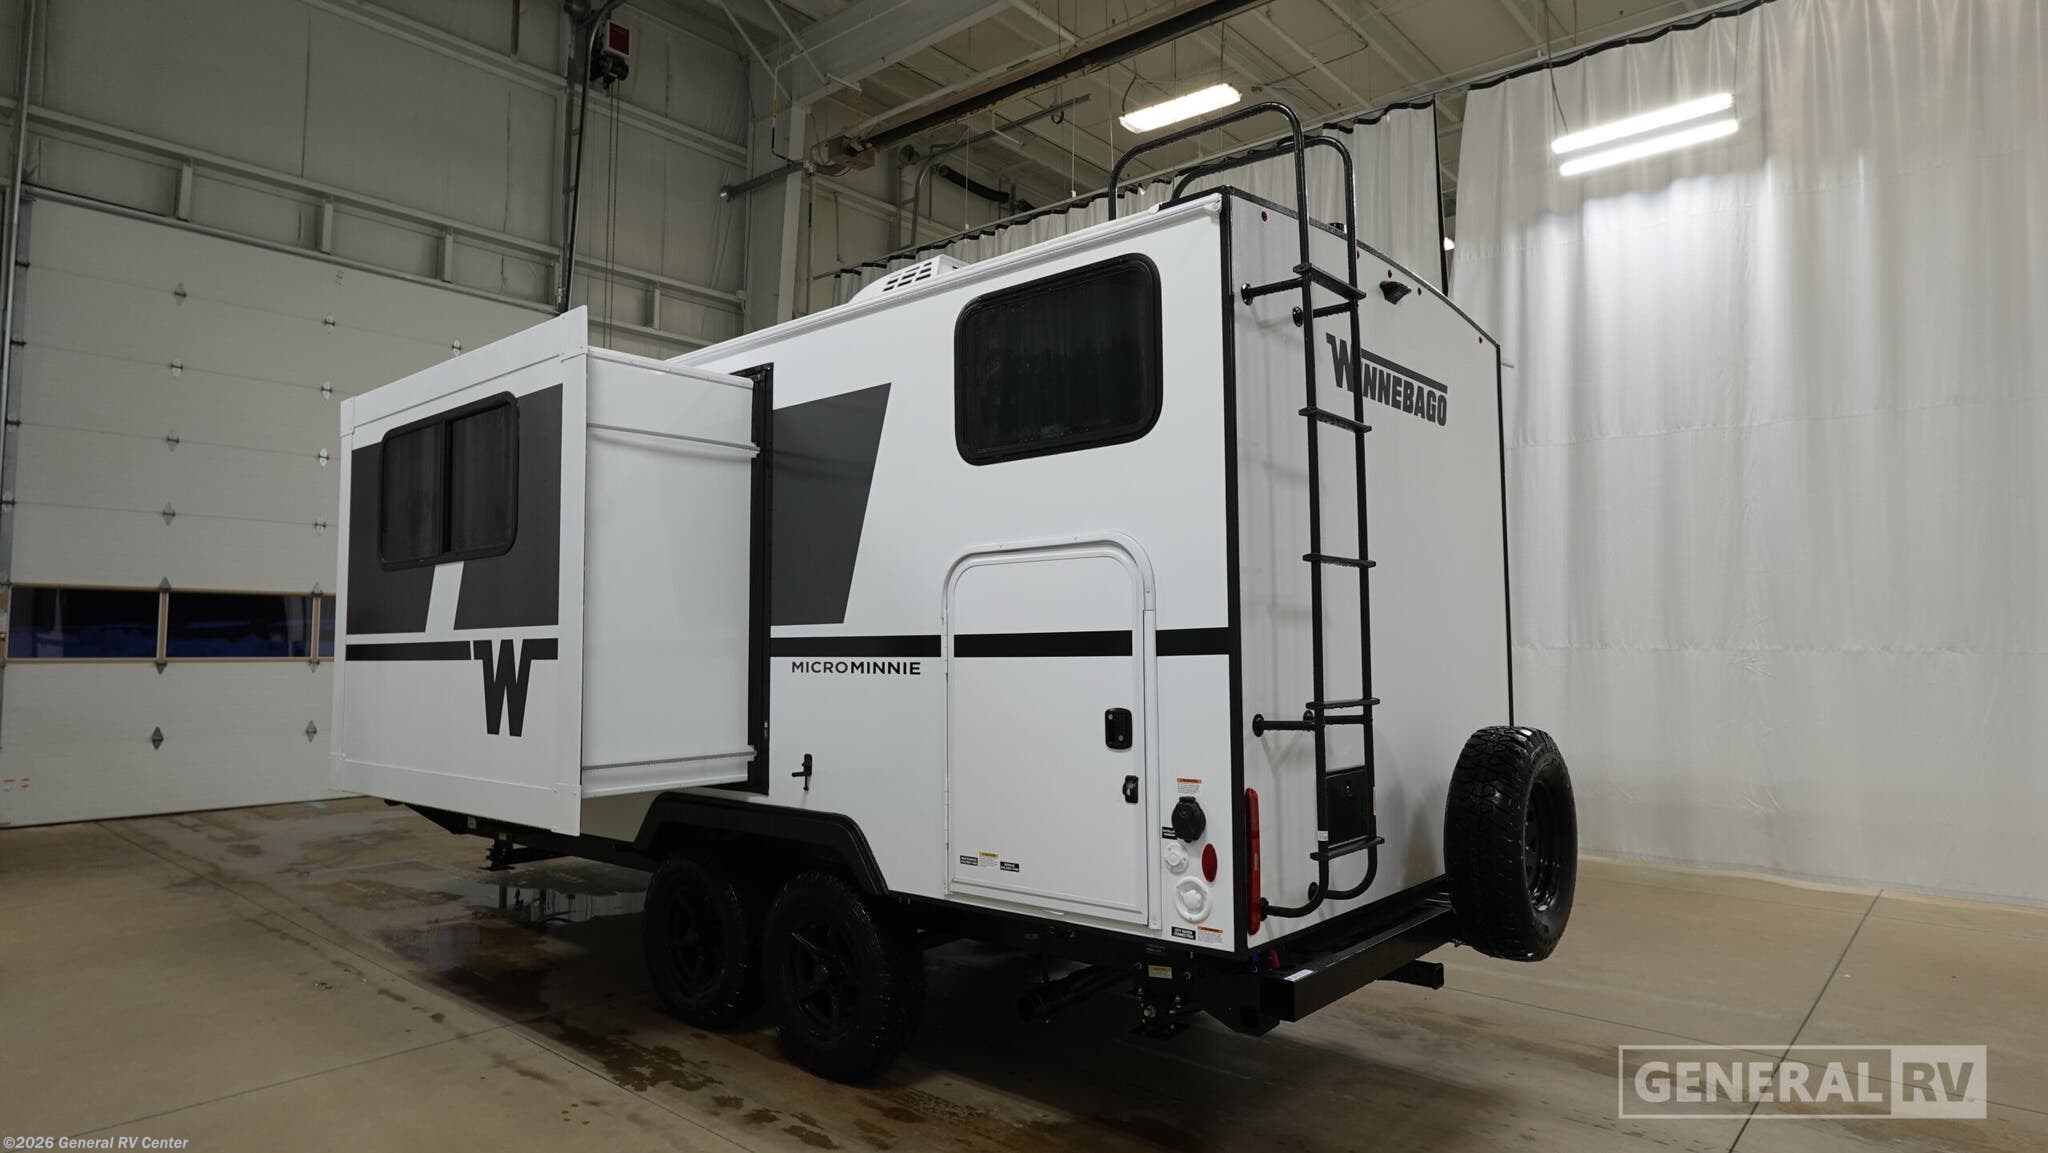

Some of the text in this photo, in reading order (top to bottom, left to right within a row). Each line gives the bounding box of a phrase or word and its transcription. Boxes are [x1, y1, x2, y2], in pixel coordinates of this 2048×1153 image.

[1325, 332, 1448, 427] WNNEBAGO
[473, 638, 559, 737] W
[791, 661, 921, 675] MICROMINNIE
